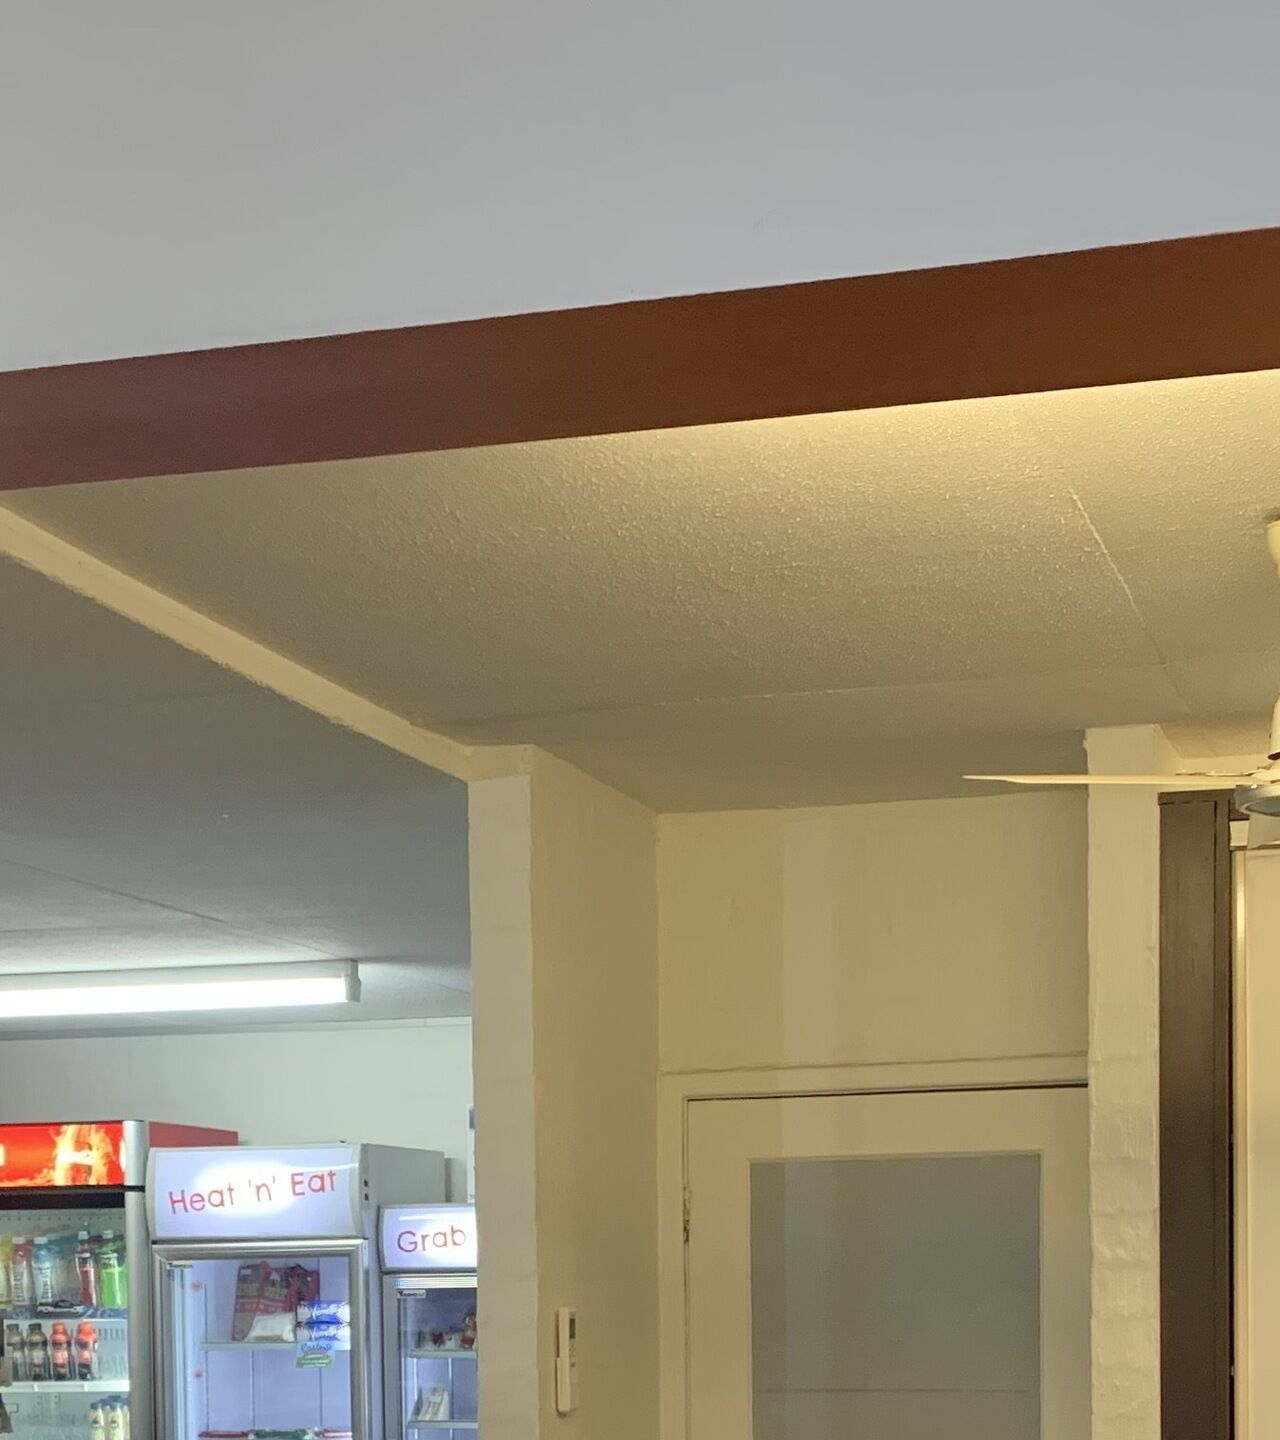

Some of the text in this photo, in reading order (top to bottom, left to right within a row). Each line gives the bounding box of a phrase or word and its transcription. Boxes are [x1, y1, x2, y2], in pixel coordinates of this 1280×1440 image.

[168, 1169, 337, 1214] Heat 'n' Eat
[396, 1225, 467, 1252] Grab
